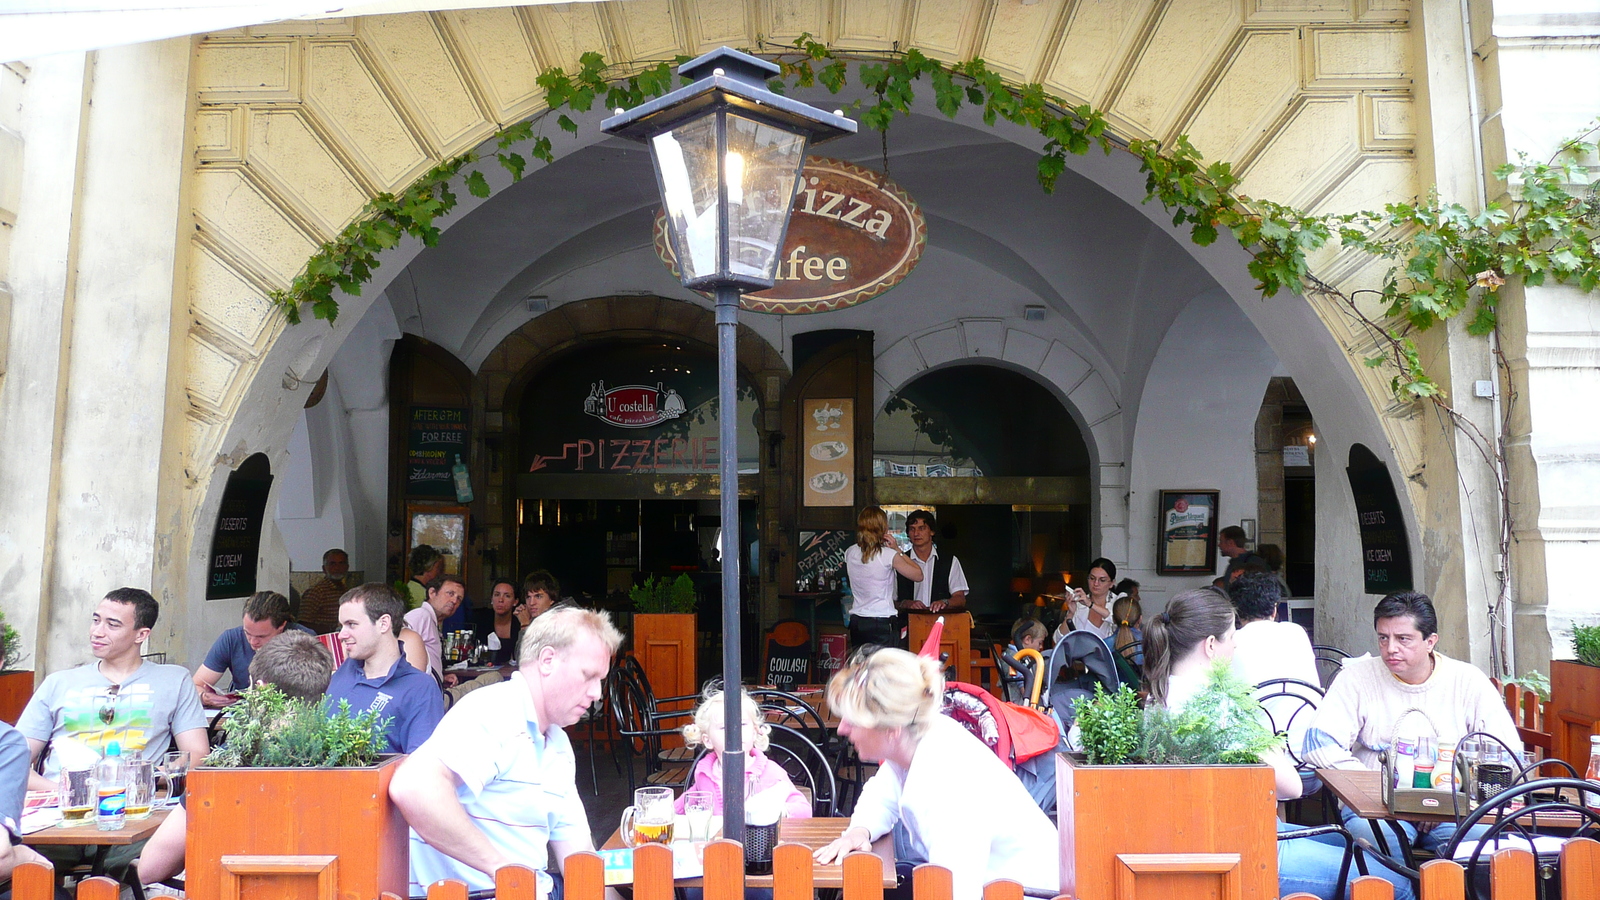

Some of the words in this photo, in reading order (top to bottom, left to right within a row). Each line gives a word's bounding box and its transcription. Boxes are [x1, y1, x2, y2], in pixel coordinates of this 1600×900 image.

[776, 174, 893, 240] Pizza
[607, 397, 617, 413] U
[619, 394, 654, 413] costella
[413, 409, 439, 421] AFTER
[421, 431, 439, 442] FOR
[440, 431, 462, 442] FREE
[576, 437, 719, 471] PIZZERIE
[408, 468, 451, 480] Zdarma
[220, 517, 248, 530] DESERTS
[1360, 510, 1386, 525] DESERTS
[215, 554, 224, 568] ICE
[223, 553, 243, 567] CREAM
[1375, 549, 1393, 562] CREAM
[212, 572, 237, 587] SALADS
[1367, 569, 1388, 582] SALADS
[769, 657, 808, 674] GOULASH
